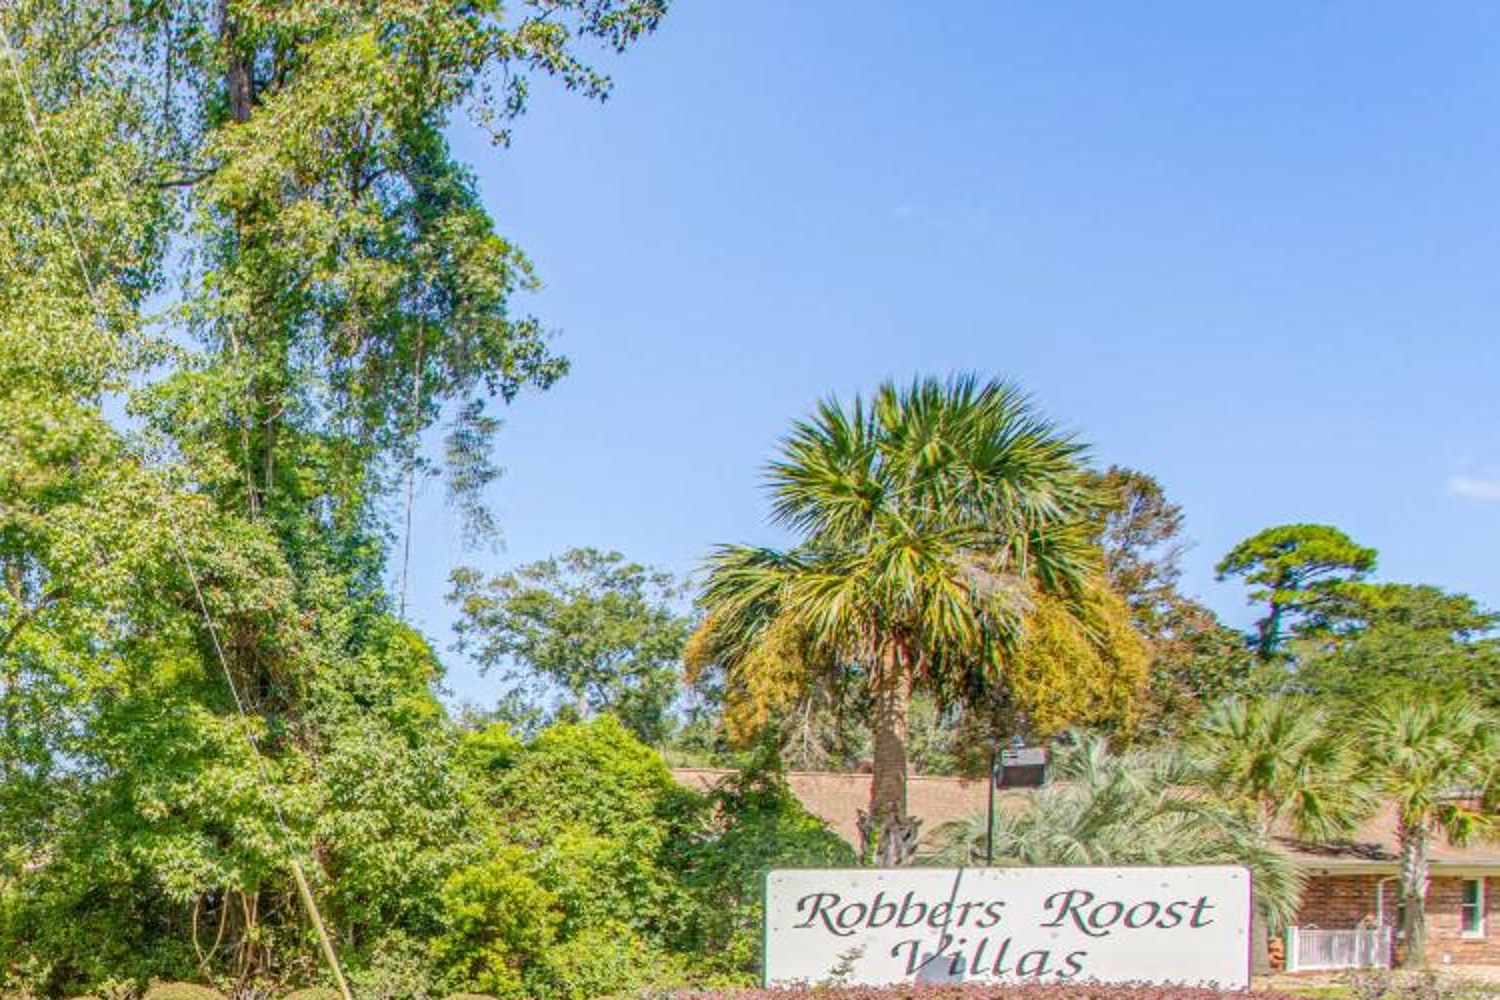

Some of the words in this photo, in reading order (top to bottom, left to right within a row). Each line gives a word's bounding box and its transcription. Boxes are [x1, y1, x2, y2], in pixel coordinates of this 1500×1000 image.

[794, 891, 1006, 936] Robbers
[1041, 889, 1216, 937] Roost
[891, 934, 1088, 979] Villas
